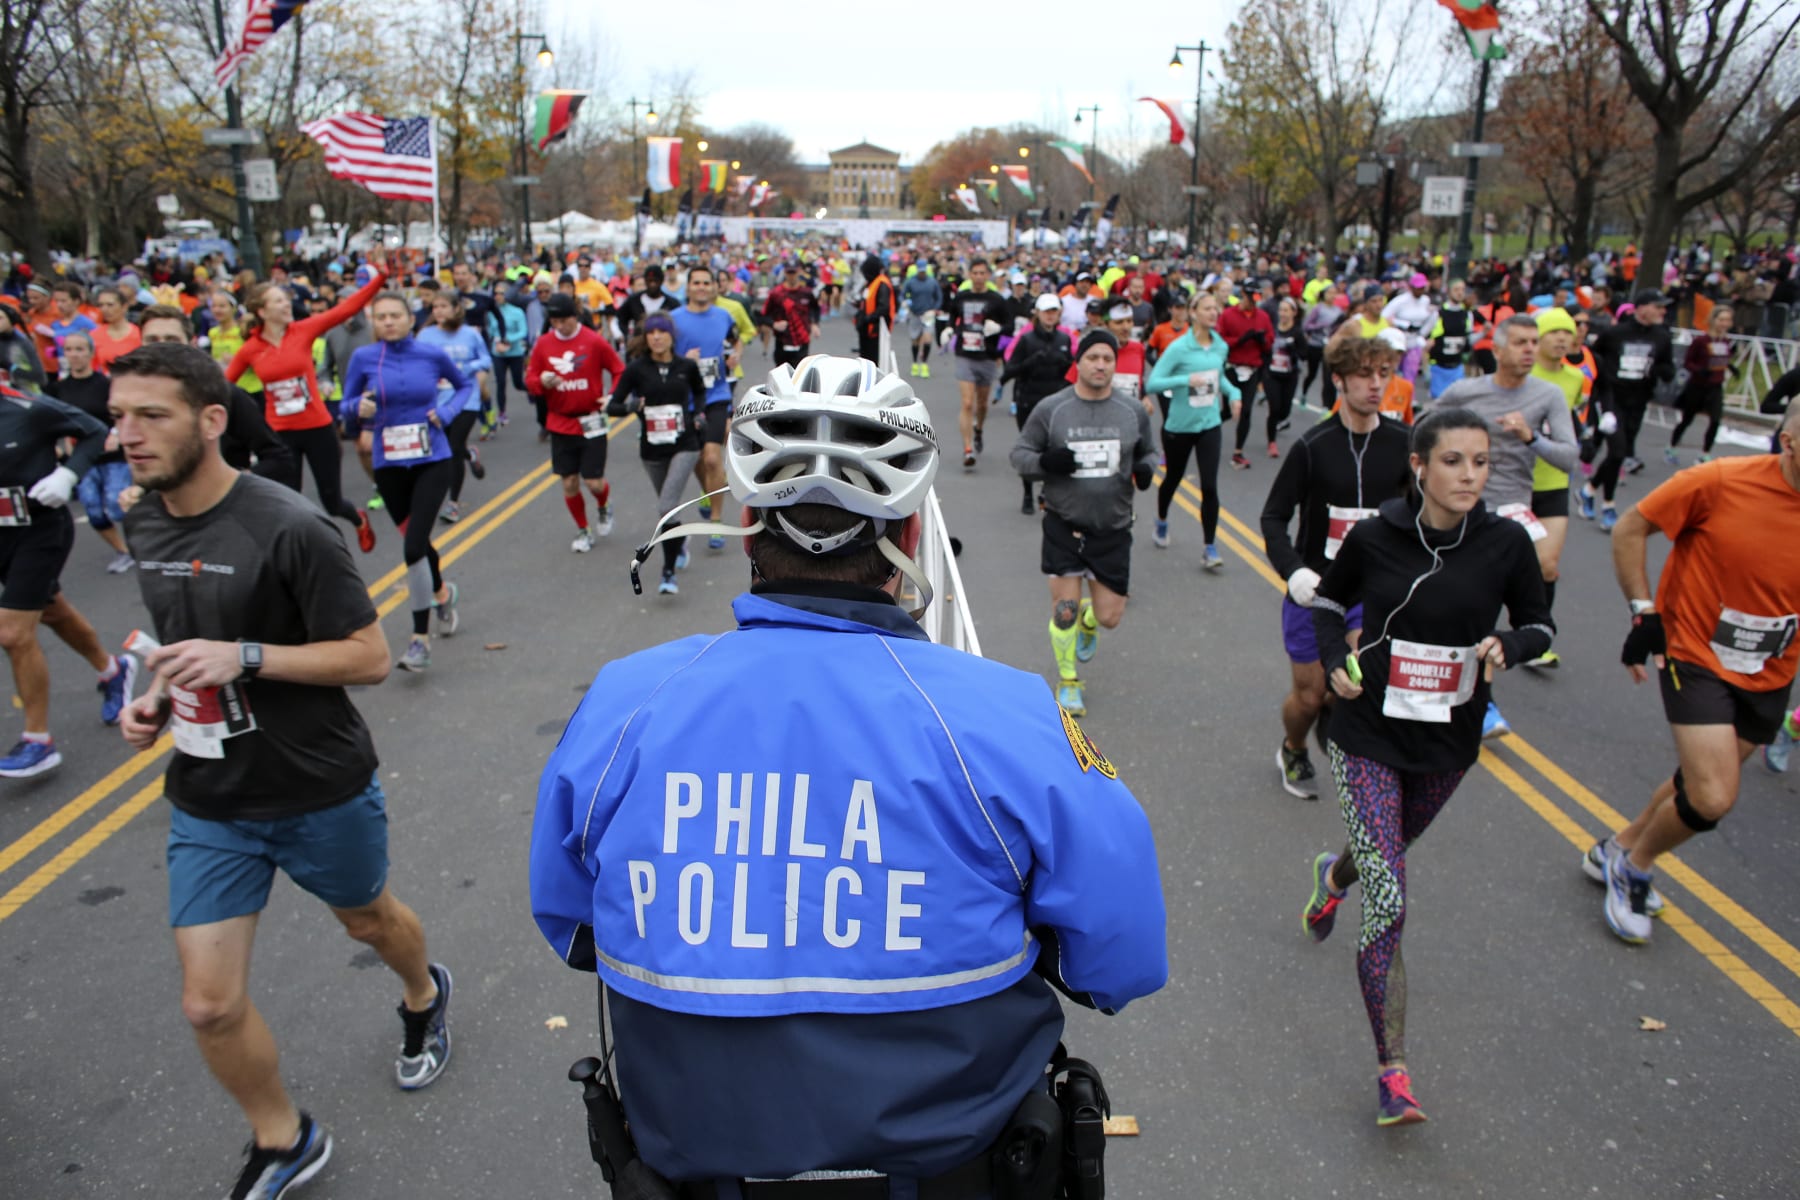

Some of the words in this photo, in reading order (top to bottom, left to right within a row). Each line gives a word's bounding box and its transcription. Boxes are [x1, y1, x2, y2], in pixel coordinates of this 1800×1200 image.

[745, 399, 776, 416] POLICE
[1399, 660, 1453, 680] MARIELLE
[662, 771, 883, 864] PHILA
[627, 860, 926, 951] POLICE
